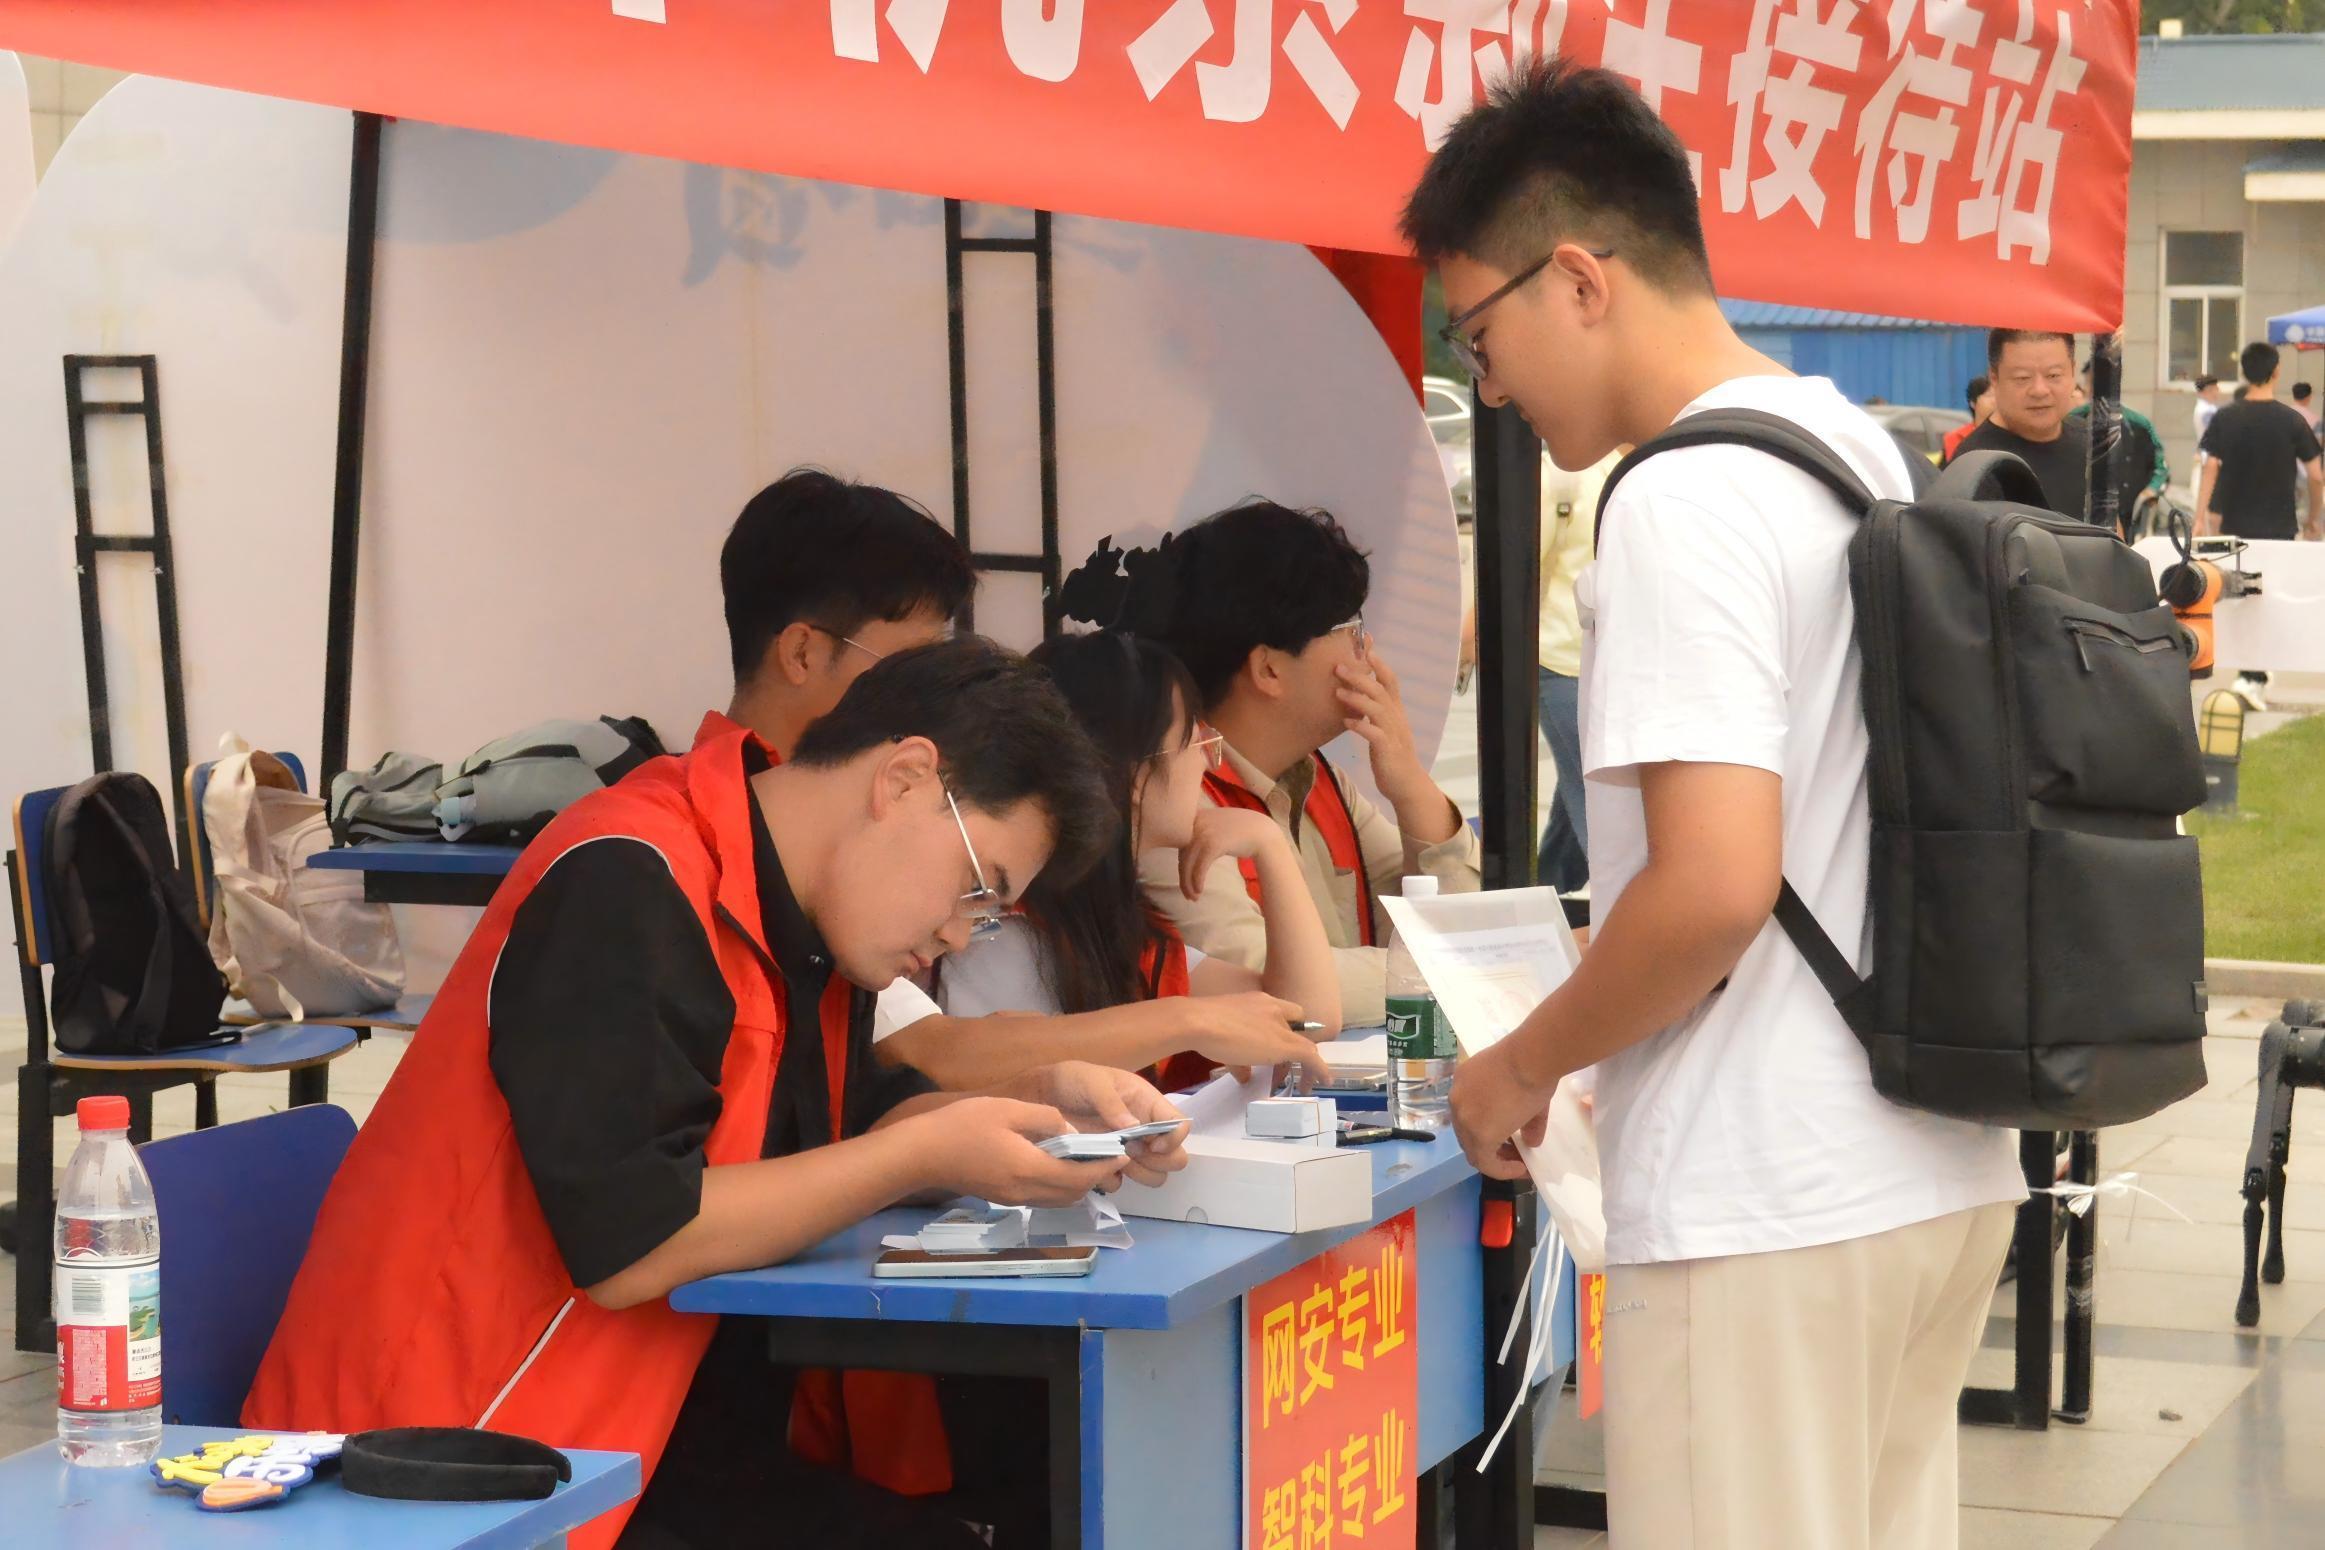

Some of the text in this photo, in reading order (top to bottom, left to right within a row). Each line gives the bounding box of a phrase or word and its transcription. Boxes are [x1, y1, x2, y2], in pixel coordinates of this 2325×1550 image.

[1262, 1243, 1405, 1429] 网安专业
[1261, 1407, 1405, 1550] 智科专业
